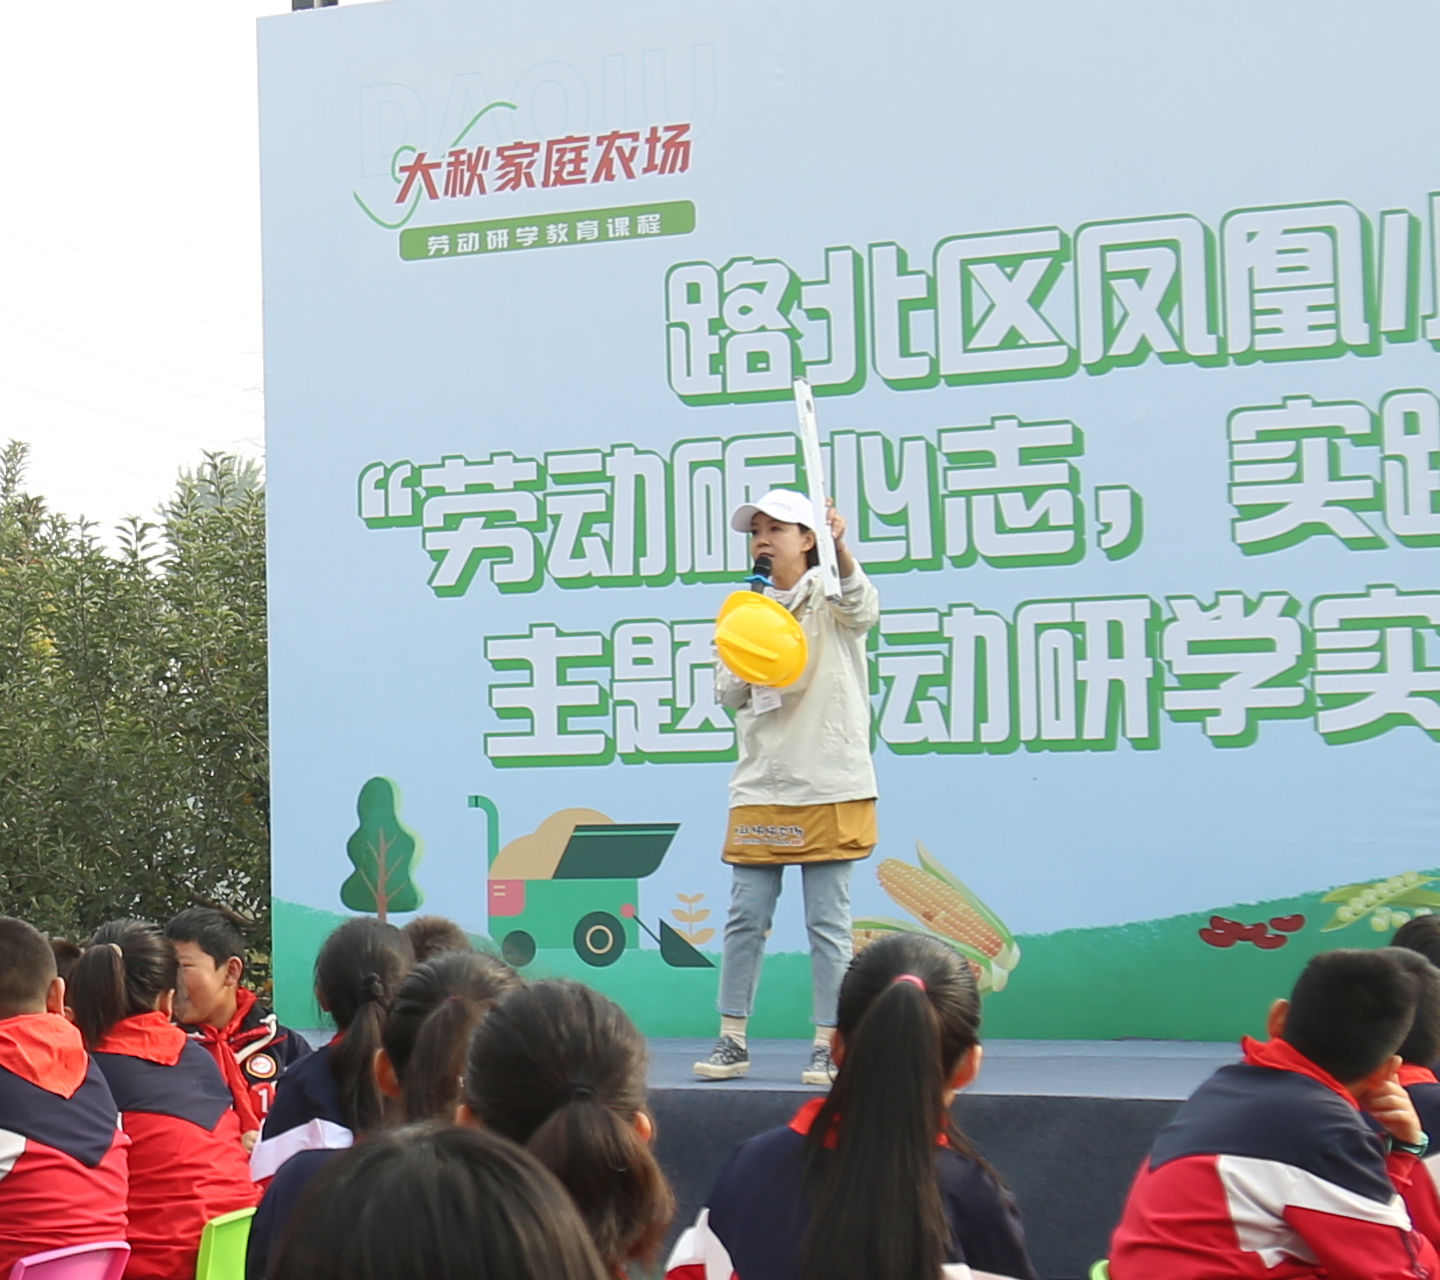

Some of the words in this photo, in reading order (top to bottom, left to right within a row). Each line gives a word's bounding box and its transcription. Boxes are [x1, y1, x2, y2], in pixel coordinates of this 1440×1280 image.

[394, 122, 692, 204] 大秋家庭农场
[427, 213, 662, 256] 劳动研学教育课程
